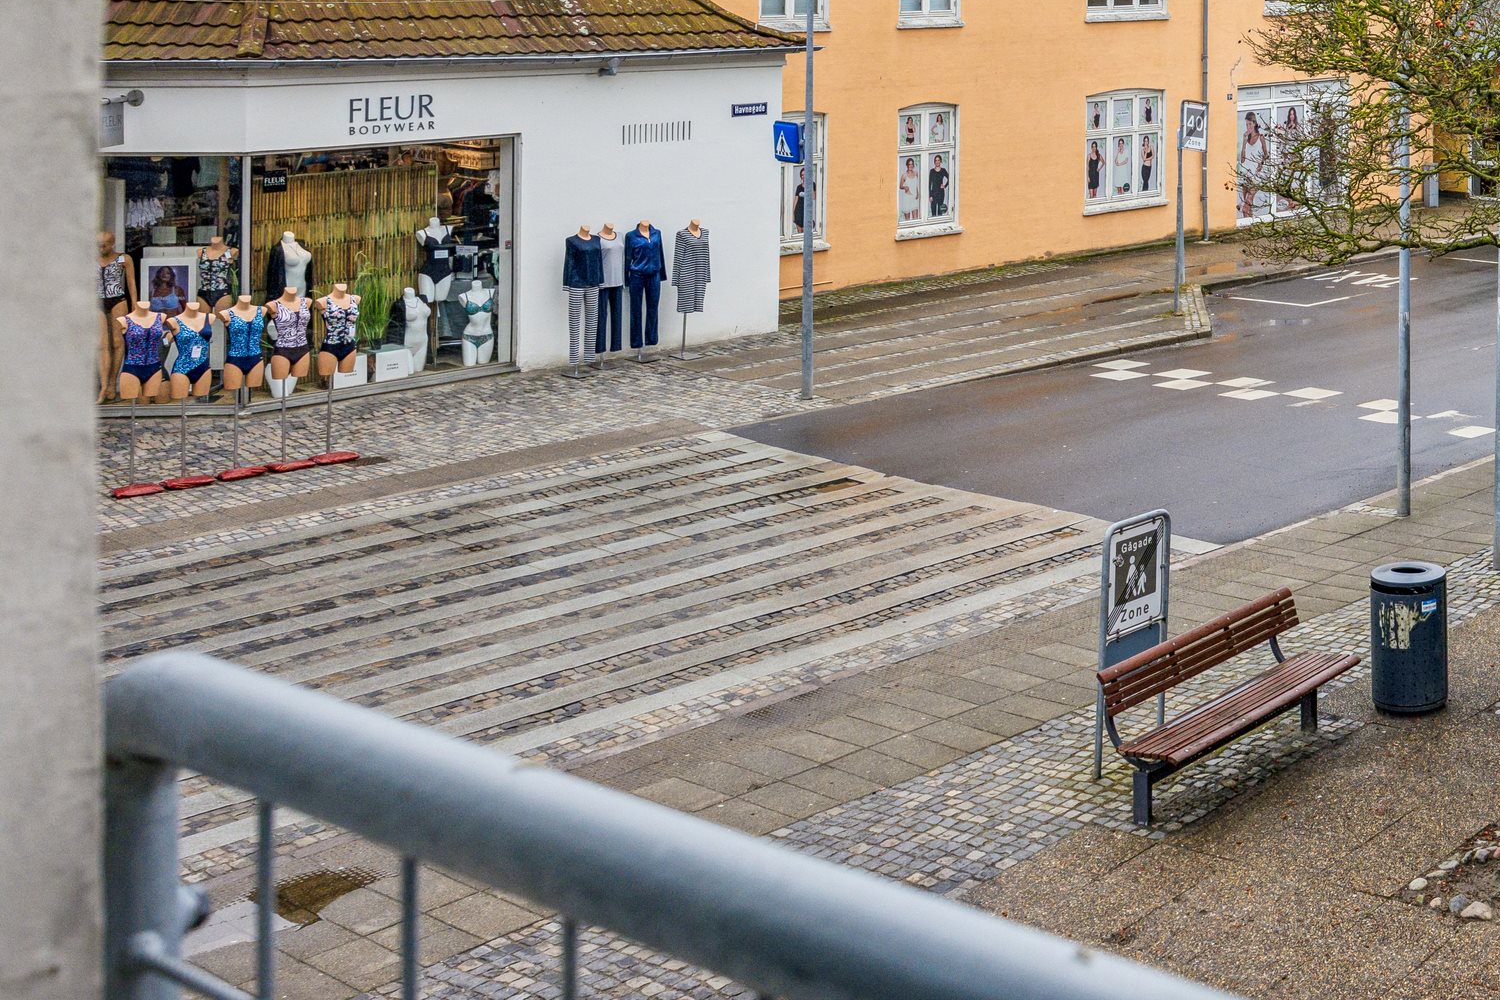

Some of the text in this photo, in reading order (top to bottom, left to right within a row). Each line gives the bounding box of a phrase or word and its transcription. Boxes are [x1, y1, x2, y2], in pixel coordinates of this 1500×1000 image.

[349, 94, 435, 124] FLEUR
[735, 104, 765, 114] Havnegade
[349, 120, 435, 136] BODYWEAR
[1187, 115, 1204, 132] 40
[1188, 138, 1201, 147] Zone
[264, 176, 286, 184] FLEUR
[1121, 536, 1152, 553] Gågade
[1120, 602, 1149, 622] Zone
